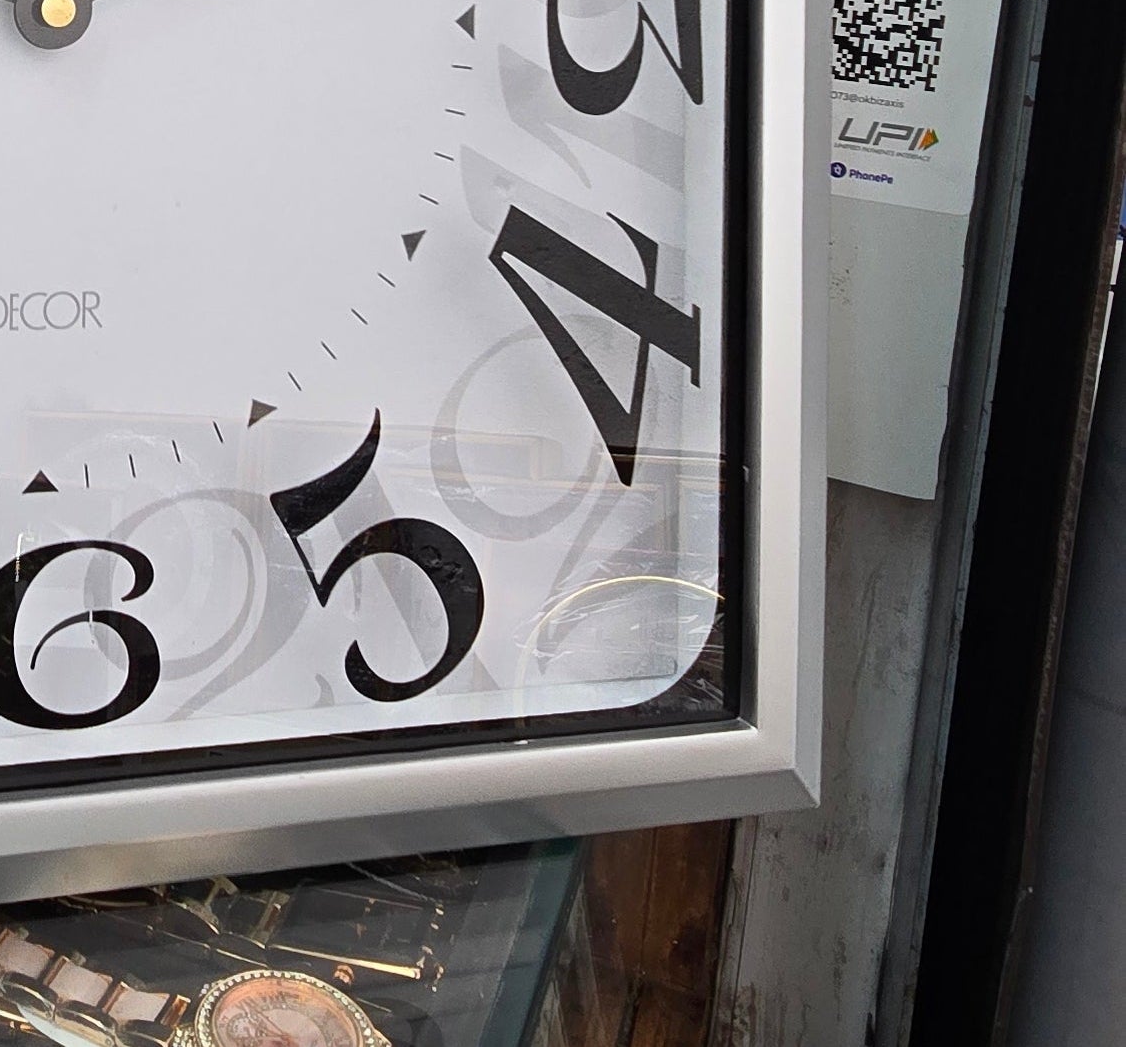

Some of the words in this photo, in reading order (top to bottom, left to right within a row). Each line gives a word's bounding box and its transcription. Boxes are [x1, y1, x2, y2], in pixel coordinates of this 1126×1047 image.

[839, 117, 925, 151] UPI
[849, 169, 894, 184] PhonePe
[488, 205, 702, 486] 4
[270, 408, 485, 702] 5
